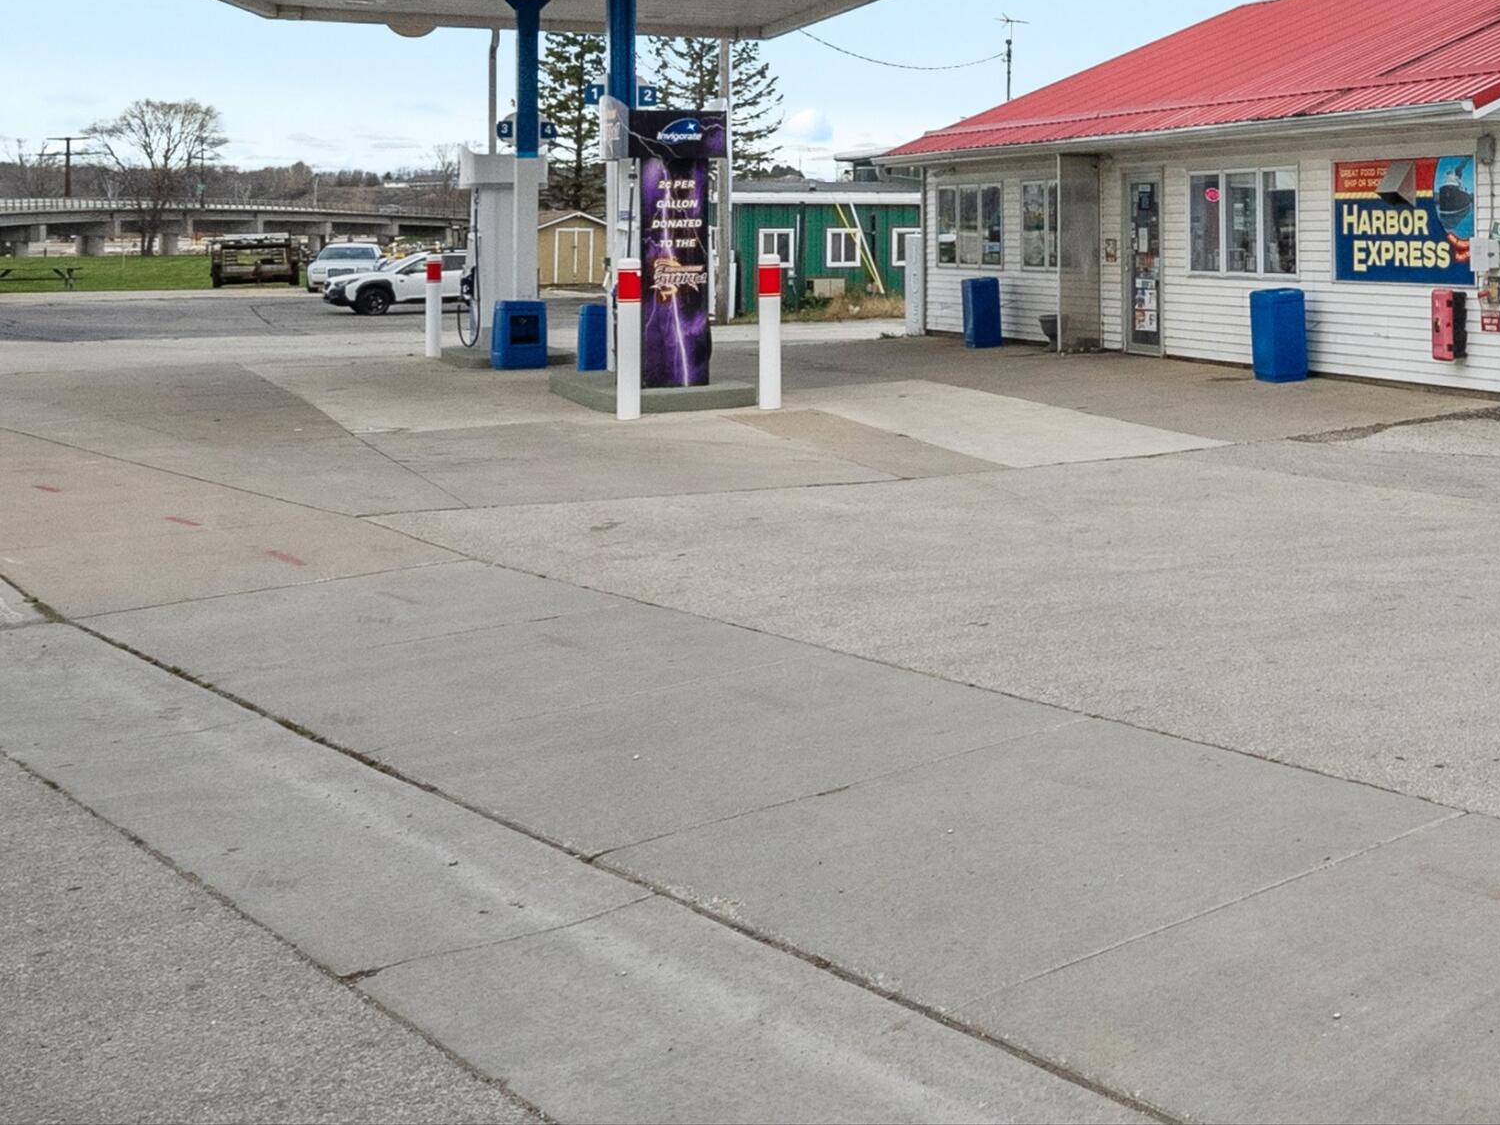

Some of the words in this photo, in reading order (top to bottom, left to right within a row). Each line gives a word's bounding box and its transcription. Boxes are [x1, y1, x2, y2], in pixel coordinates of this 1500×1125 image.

[591, 87, 598, 100] 1
[643, 89, 653, 101] 2
[500, 123, 508, 134] 3
[543, 123, 552, 135] 4
[673, 180, 696, 190] PER
[656, 199, 698, 209] GALLON
[652, 219, 703, 230] DONATED
[1342, 204, 1429, 235] HARBOR
[659, 239, 673, 249] TO
[675, 238, 697, 248] THE
[1353, 240, 1450, 272] EXPRESS
